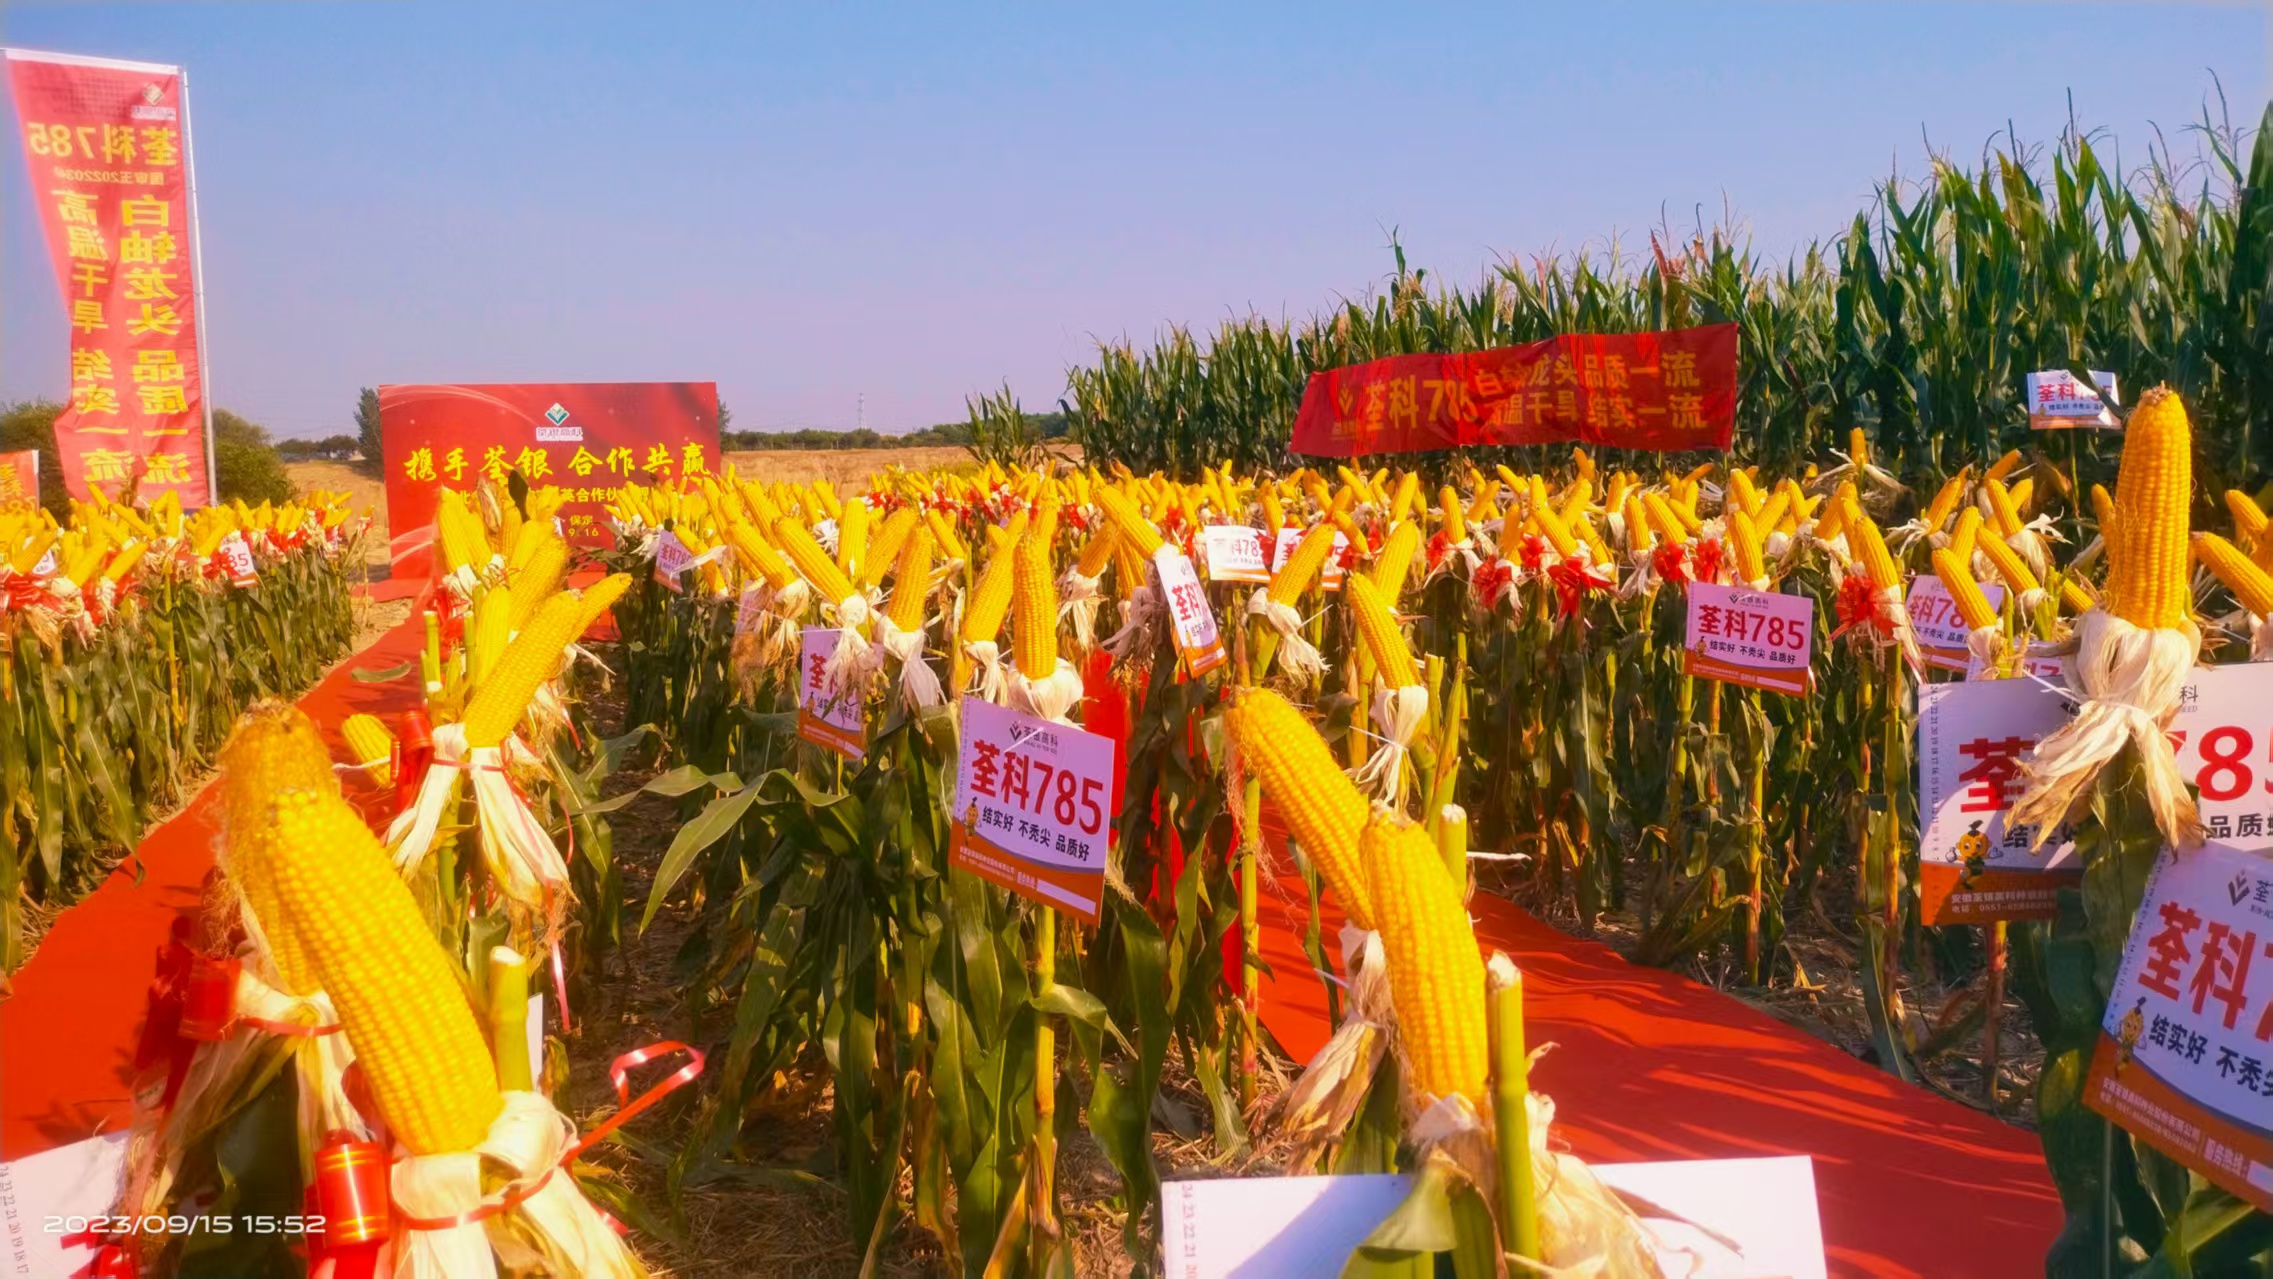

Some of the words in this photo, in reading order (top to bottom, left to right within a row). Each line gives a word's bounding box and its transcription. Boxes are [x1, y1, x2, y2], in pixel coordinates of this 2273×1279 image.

[1698, 604, 1805, 650] 荃科785
[1909, 595, 1966, 628] 荃科78
[970, 739, 1104, 835] 荃科785
[982, 805, 1014, 832] 结实好
[1018, 819, 1051, 848] 不秃尖
[1055, 834, 1090, 862] 品质好
[2149, 1014, 2207, 1066] 结实好
